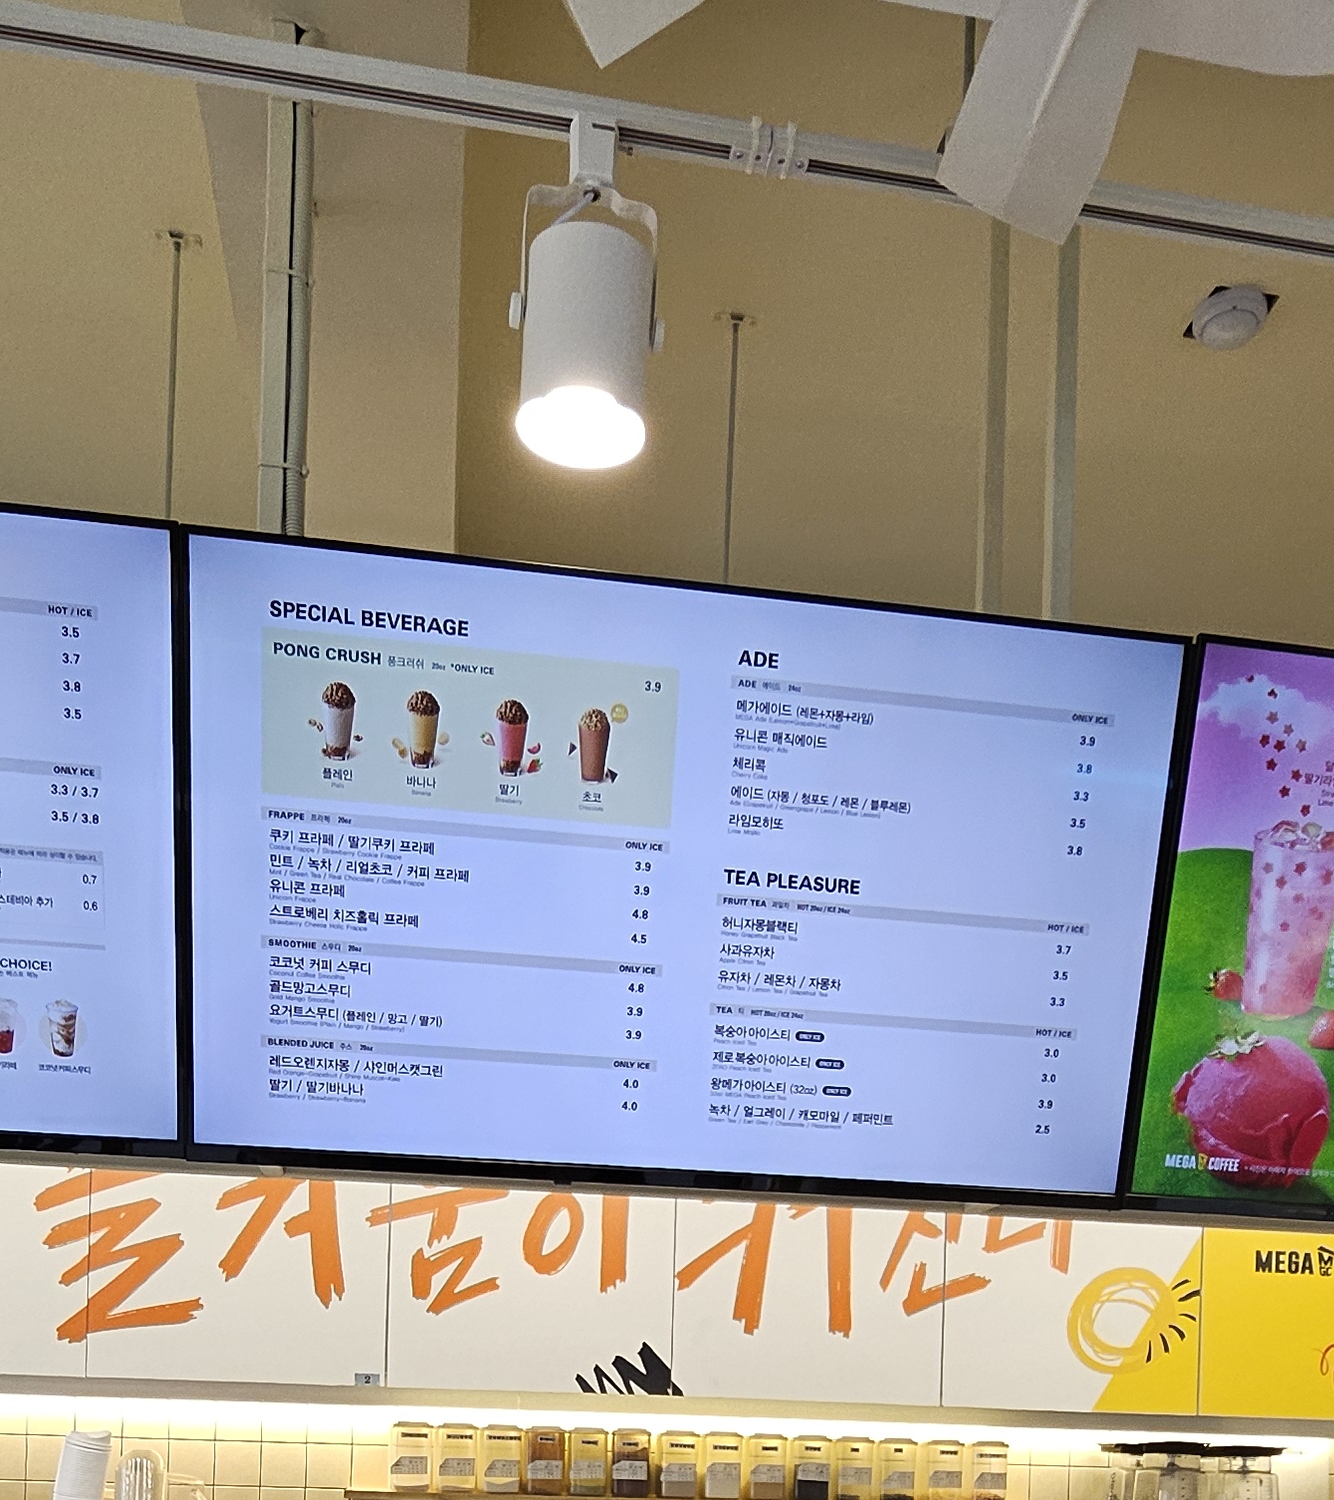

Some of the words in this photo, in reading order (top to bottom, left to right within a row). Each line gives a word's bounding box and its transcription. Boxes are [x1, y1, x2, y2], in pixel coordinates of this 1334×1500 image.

[269, 600, 355, 625] SPECIAL
[361, 611, 469, 637] BEVERAGE
[273, 642, 320, 660] PONG
[325, 647, 382, 665] CRUSH
[480, 666, 495, 675] ICE
[738, 650, 779, 670] ADE
[645, 680, 661, 693] 3.9
[322, 767, 354, 783] 플레인
[406, 775, 437, 789] 바나나
[499, 783, 520, 797] 딸기
[582, 791, 602, 804] 초코
[51, 811, 69, 823] 3.5
[80, 813, 100, 825] 3.8
[268, 810, 305, 821] FRAPPE
[270, 829, 294, 844] 쿠키
[298, 831, 334, 847] 프라페
[348, 834, 396, 852] 딸기쿠키
[399, 839, 435, 856] 프라페
[1067, 845, 1083, 857] 3.8
[634, 860, 652, 873] 3.9
[269, 879, 306, 895] 유니콘
[310, 882, 345, 897] 프라페
[724, 868, 760, 888] TEA
[766, 872, 861, 895] PLEASURE
[268, 938, 316, 951] SMOOTHIE
[630, 933, 647, 945] 4.5
[720, 943, 774, 960] 사과유자차
[1056, 944, 1071, 956] 3.7
[0, 957, 52, 972] CHOICE!
[269, 956, 306, 971] 코코넛
[309, 958, 332, 972] 커피
[336, 960, 372, 975] 스무디
[718, 970, 751, 985] 유자차
[764, 973, 796, 988] 레몬차
[808, 976, 841, 991] 자몽차
[268, 1037, 307, 1049] BLENDED
[309, 1040, 334, 1050] JUICE
[622, 1101, 638, 1112] 4.0
[1165, 1155, 1196, 1169] MEGA
[1208, 1158, 1239, 1171] COFFEE
[1255, 1249, 1314, 1275] MEGA
